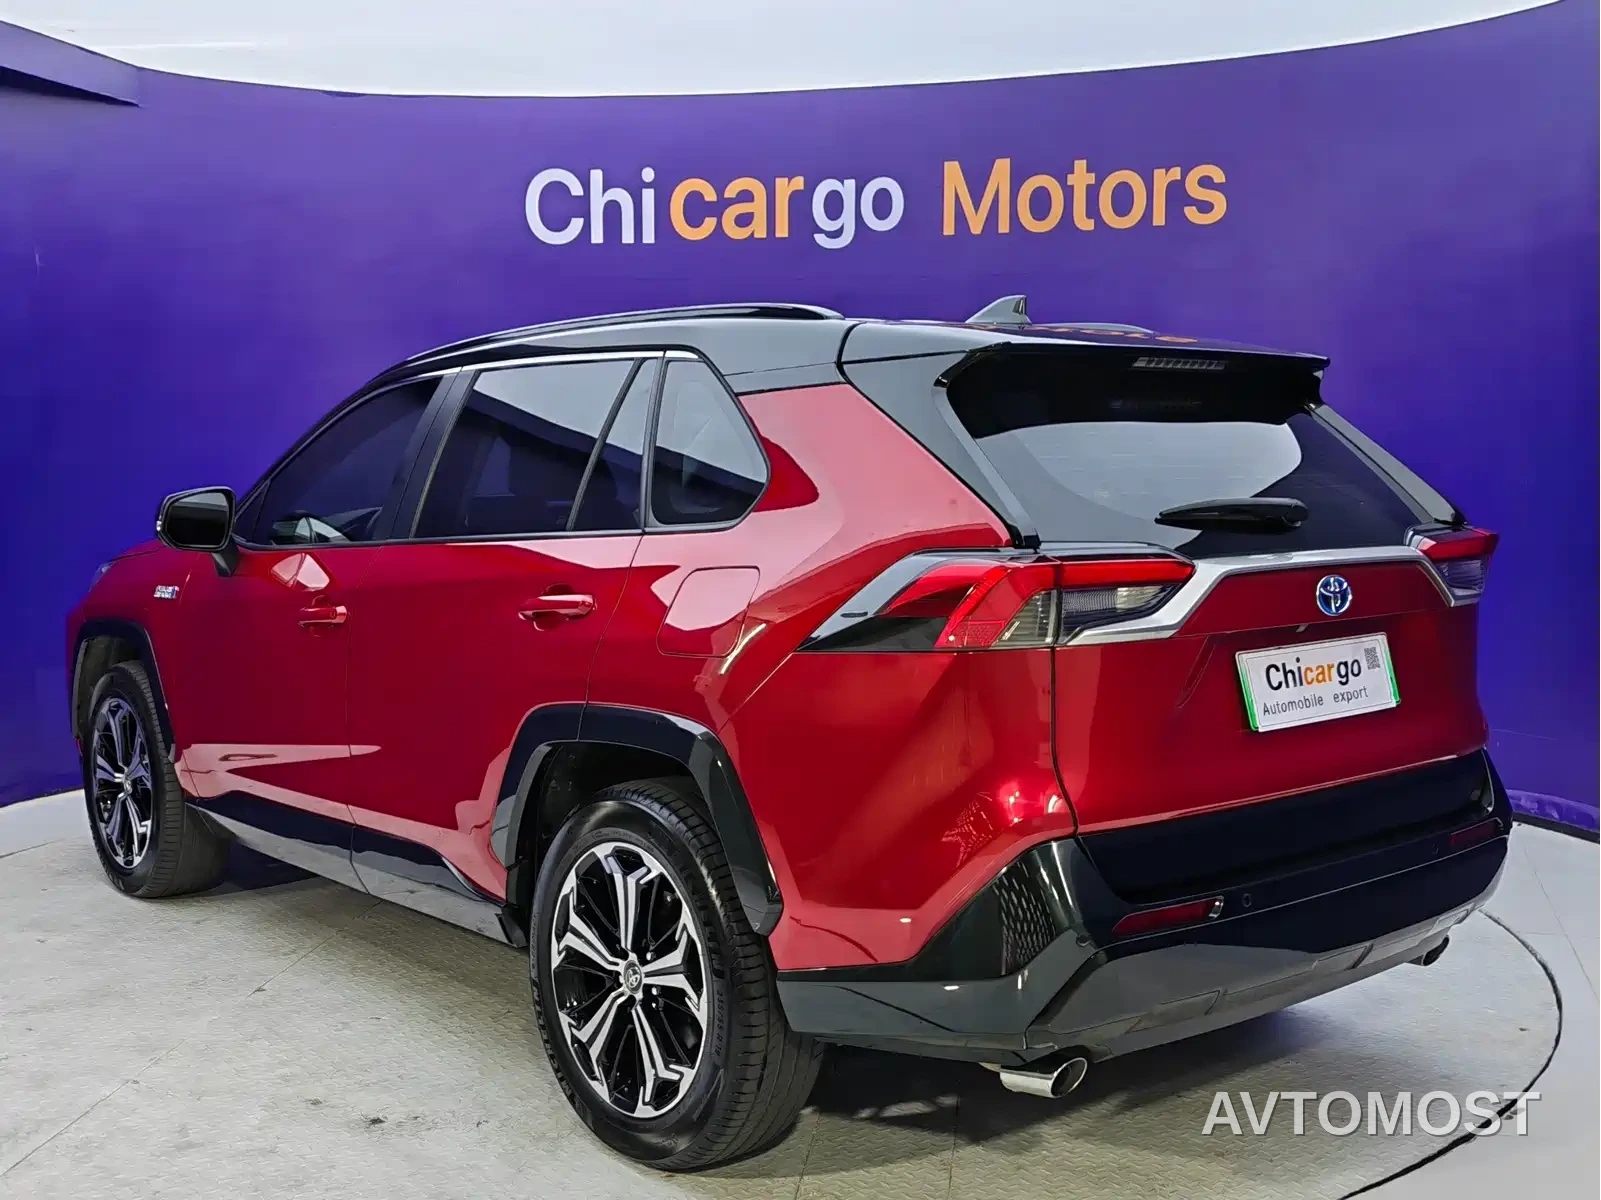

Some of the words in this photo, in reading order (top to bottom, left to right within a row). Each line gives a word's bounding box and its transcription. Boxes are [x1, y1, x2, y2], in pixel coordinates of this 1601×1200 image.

[942, 158, 1228, 236] Motors
[1265, 657, 1361, 691] Chicargo
[1263, 694, 1324, 716] Automobile
[1333, 685, 1369, 705] export
